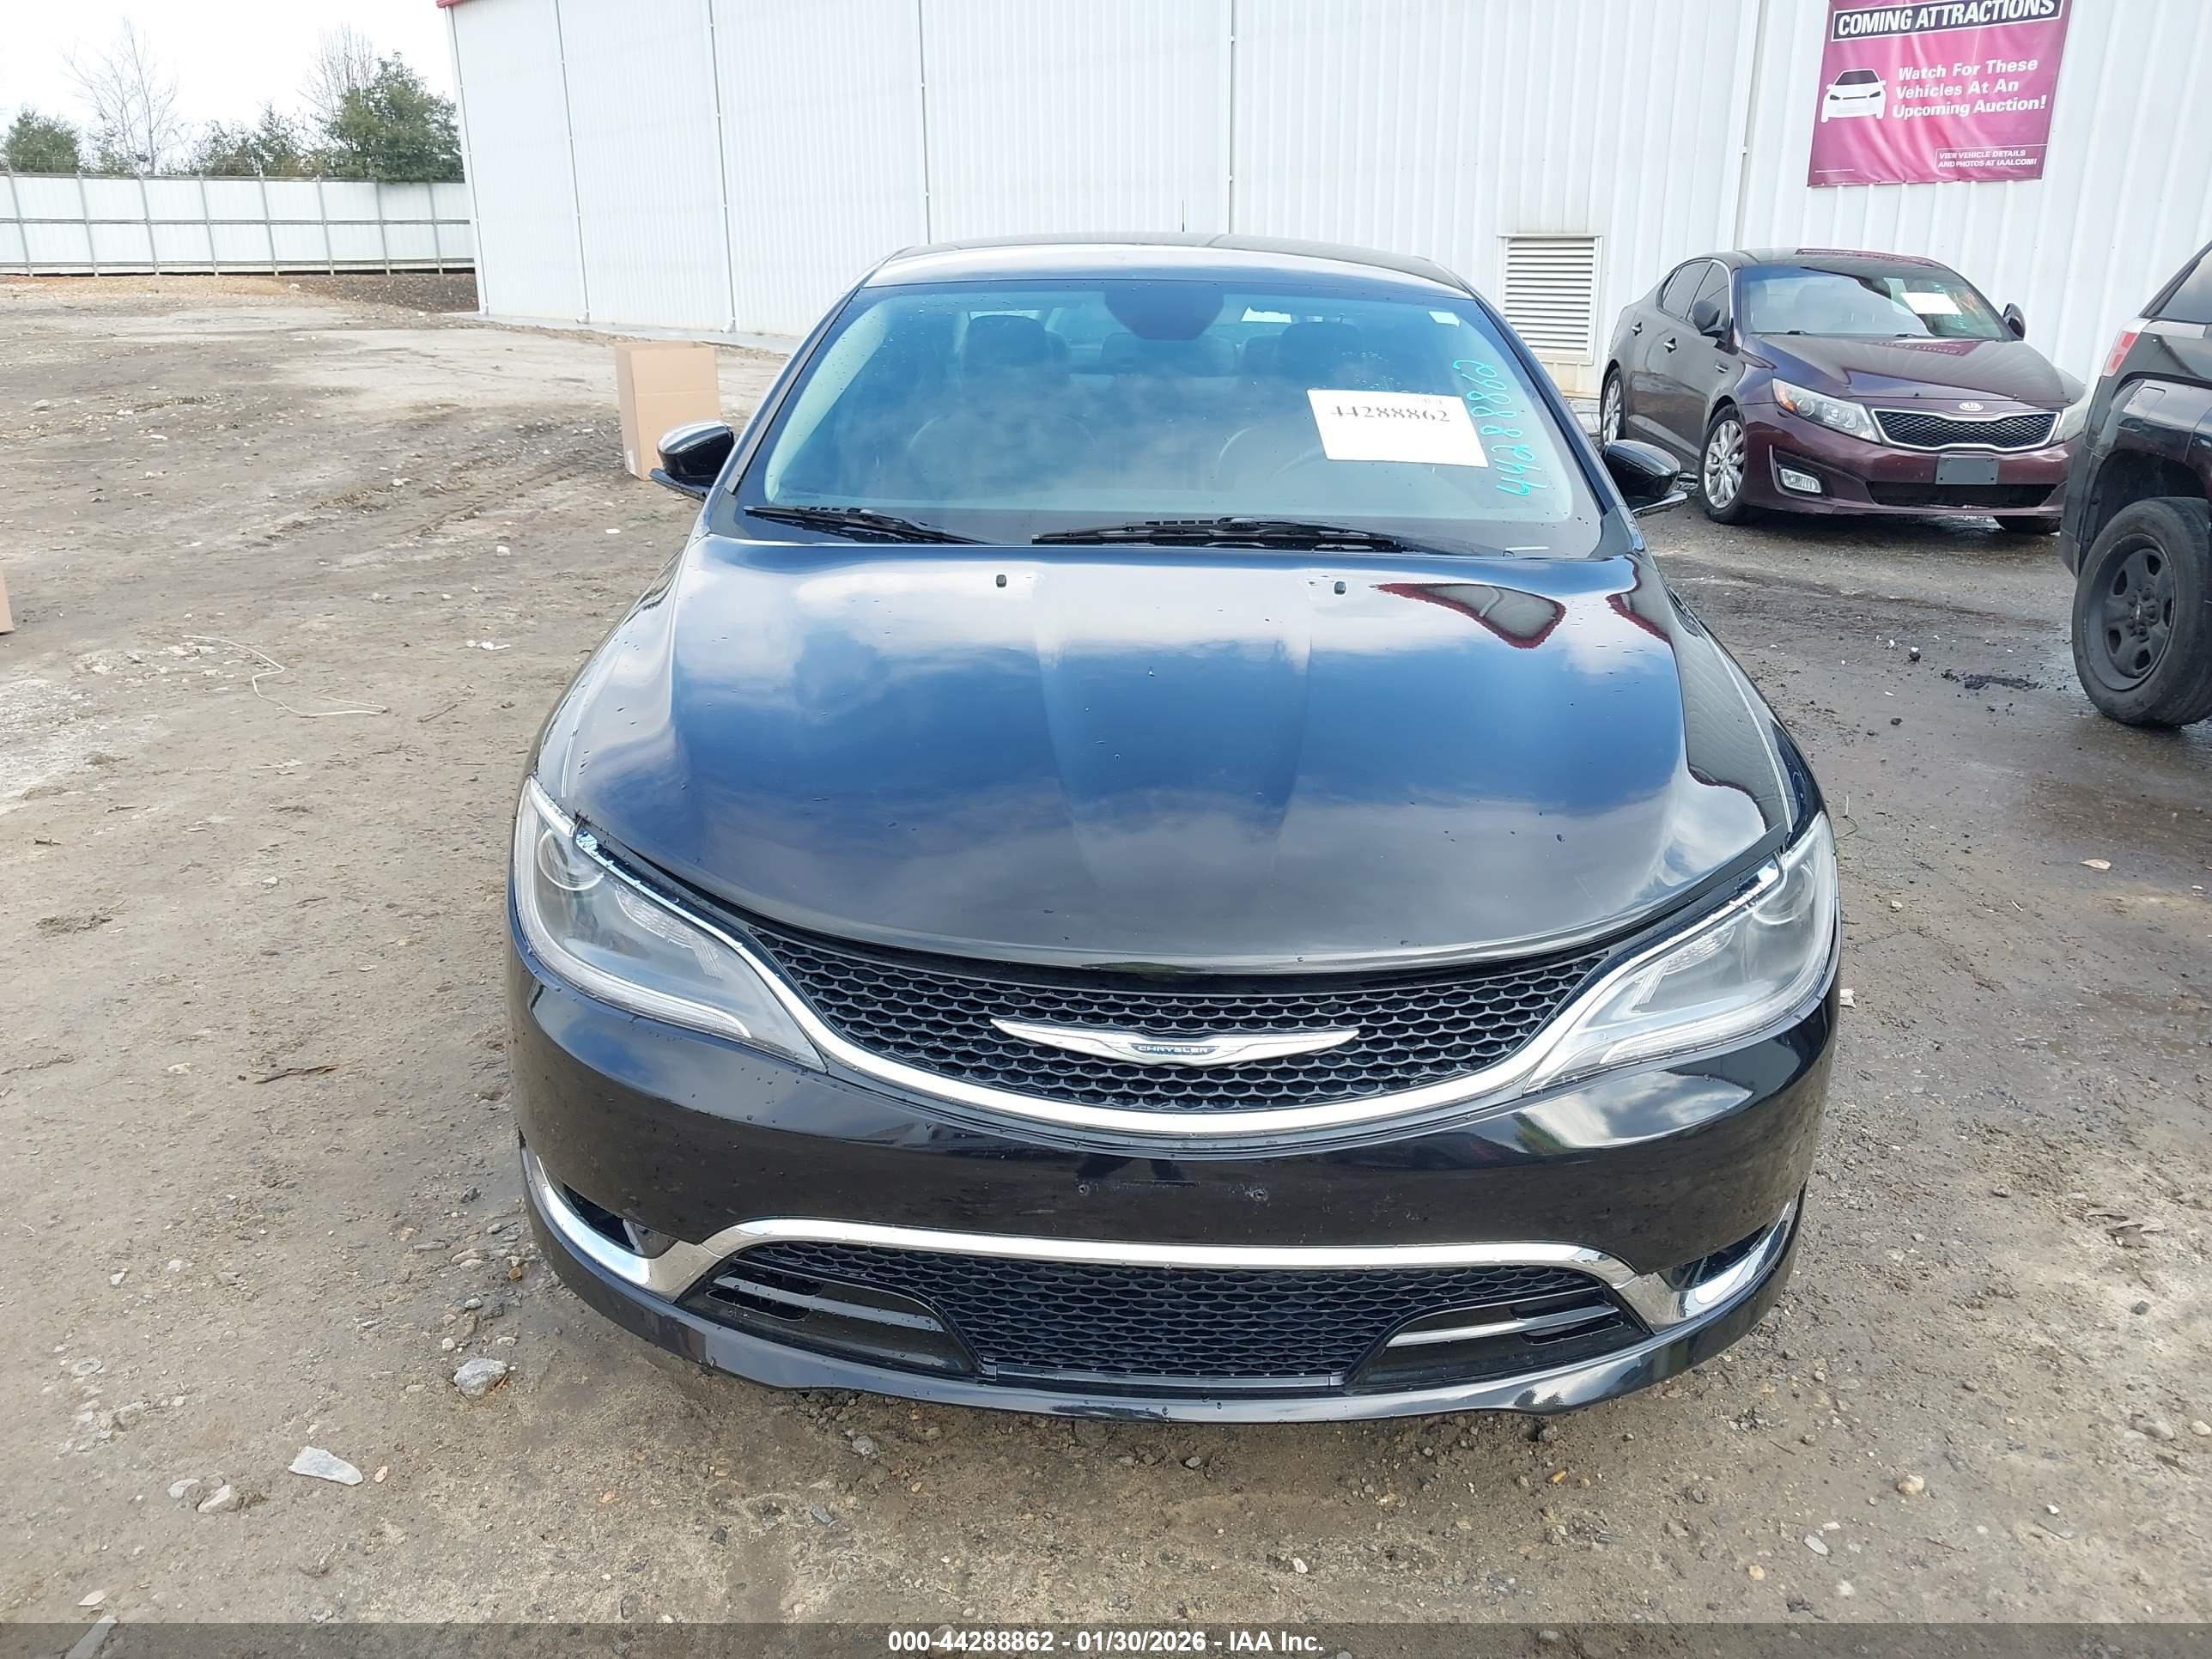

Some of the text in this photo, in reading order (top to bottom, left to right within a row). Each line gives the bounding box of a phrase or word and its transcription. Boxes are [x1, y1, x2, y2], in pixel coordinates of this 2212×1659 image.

[1838, 0, 2055, 36] COMING ATTRACTIONS
[1899, 59, 2038, 82] Watch For These
[1896, 79, 2019, 100] Vehicles At An
[1893, 94, 2046, 120] Upcoming Auction!
[1992, 149, 2026, 158] DETAILS
[1331, 405, 1450, 422] 44288862
[1452, 359, 1547, 495] 44288862
